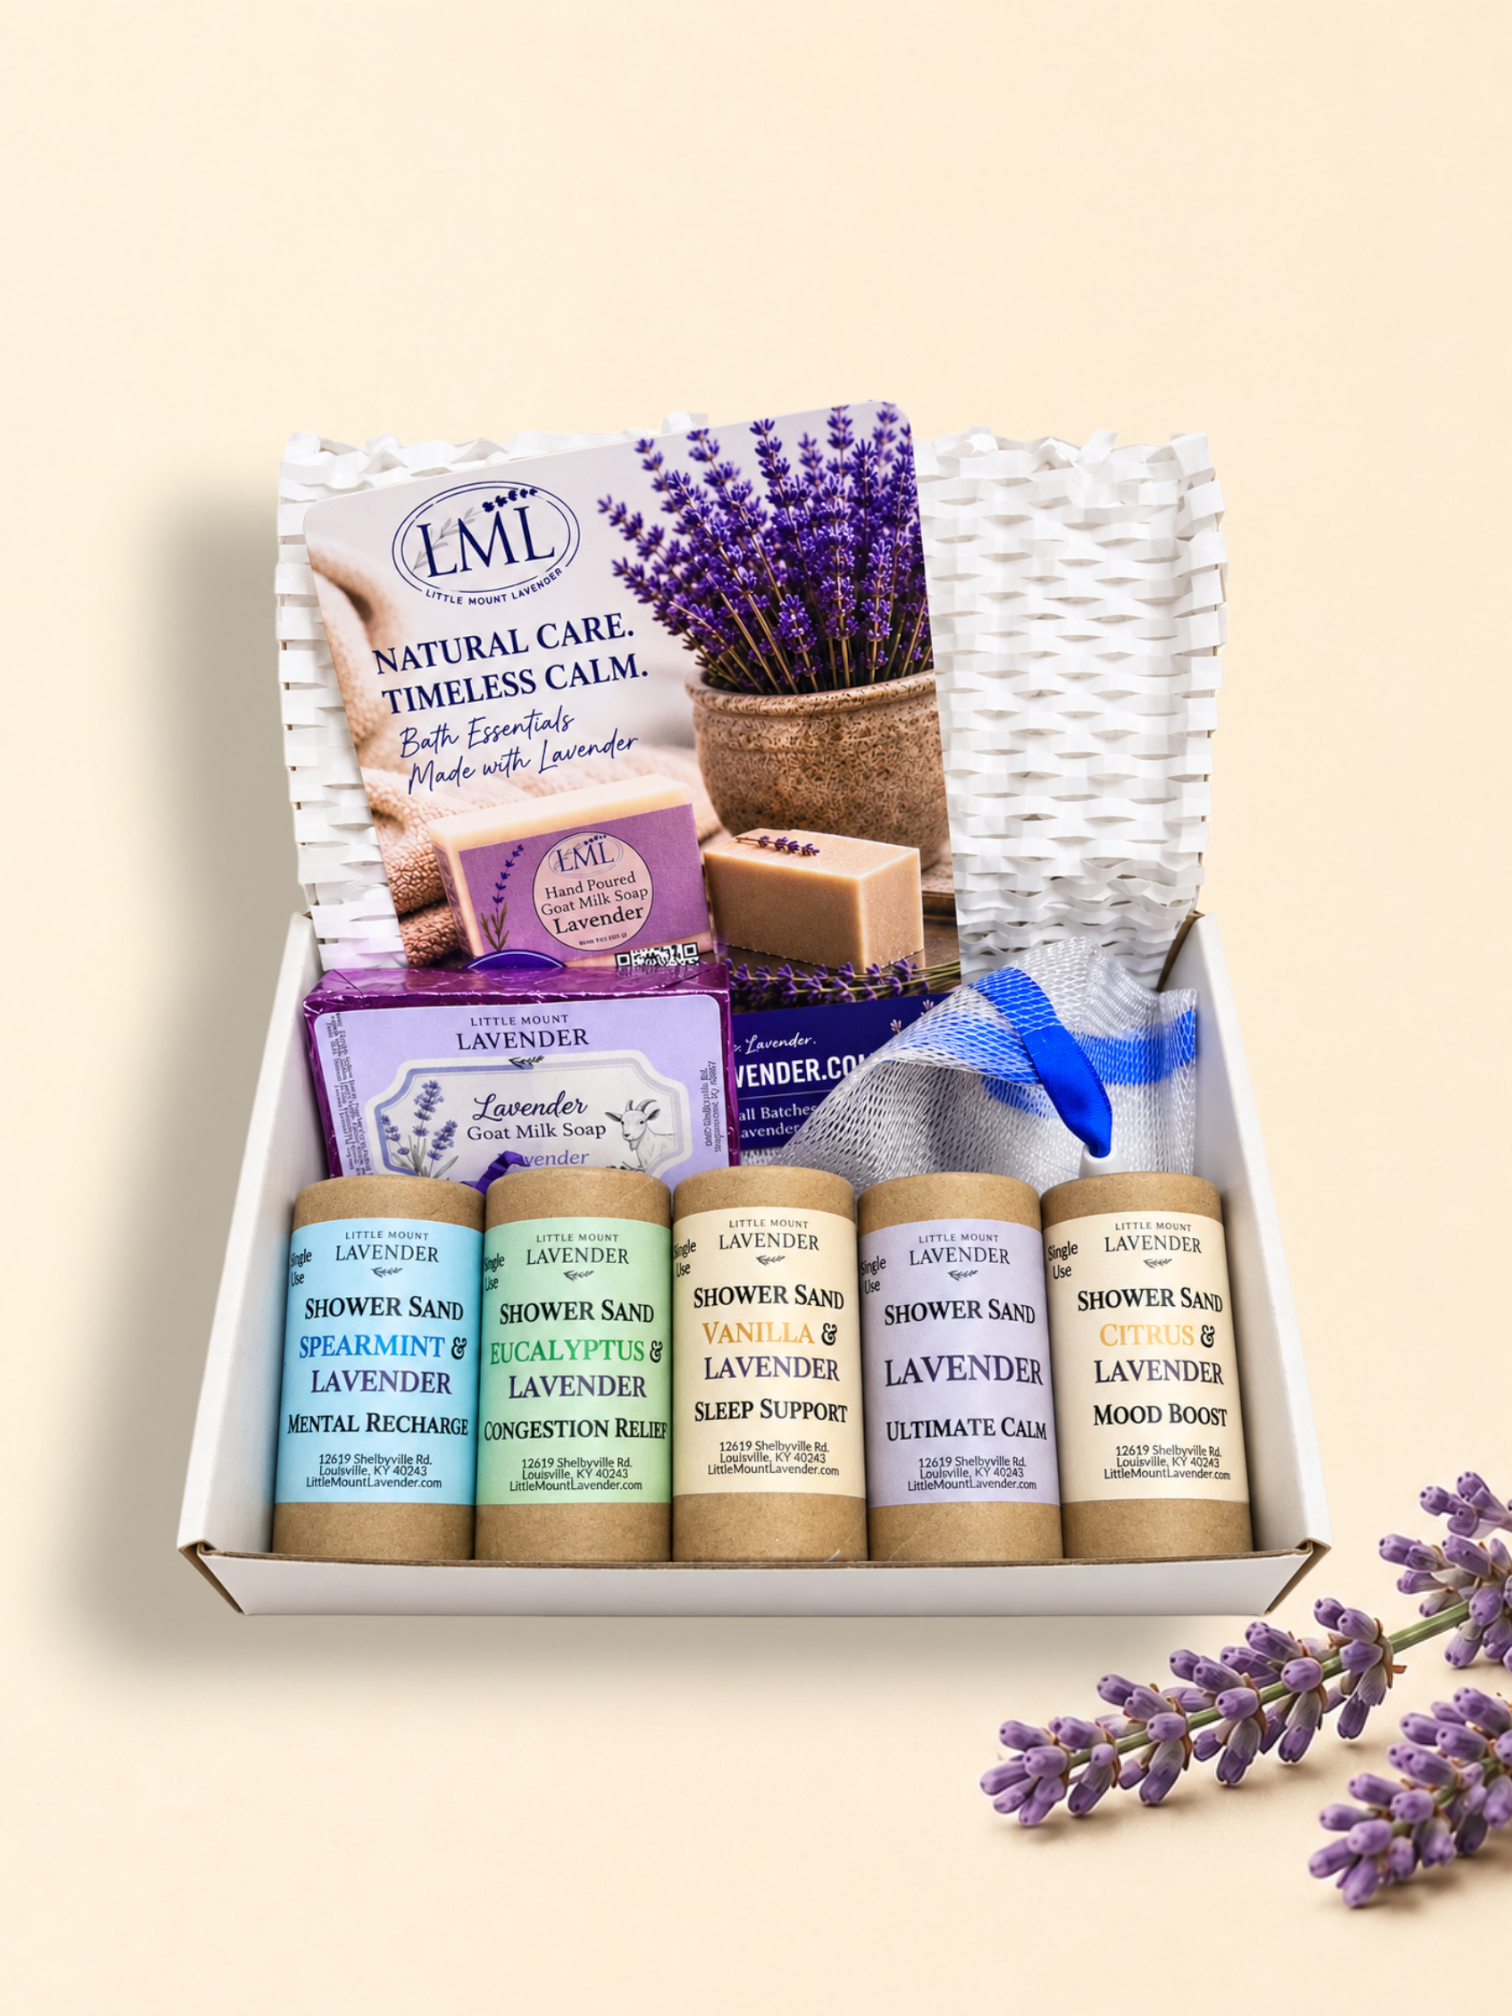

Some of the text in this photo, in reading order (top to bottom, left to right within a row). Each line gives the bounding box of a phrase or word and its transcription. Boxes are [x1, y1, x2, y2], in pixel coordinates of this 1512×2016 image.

[416, 505, 555, 578] LML
[425, 567, 563, 606] LITTLE MOUNT LAVENDER
[372, 612, 634, 675] NATURAL CARE.
[382, 653, 648, 715] TIMELESS CALM.
[399, 705, 575, 758] Bath Essentials
[408, 727, 639, 795] Made with Lavender
[556, 842, 614, 872] LML
[545, 871, 636, 899] Hand Poured
[541, 888, 649, 916] Goat Milk Soap
[553, 906, 644, 934] Lavender
[470, 1014, 569, 1026] LITTLE MOUNT
[456, 1028, 590, 1050] LAVENDER
[745, 1031, 816, 1055] Lavender.
[734, 1053, 874, 1088] VENDER.CO
[472, 1090, 588, 1122] Lavender
[738, 1107, 756, 1121] all
[467, 1122, 606, 1141] Goat Milk Soap
[740, 1121, 800, 1138] avender
[498, 1149, 590, 1167] vender
[729, 1219, 809, 1229] LITTLE MOUNT
[1115, 1222, 1191, 1232] LITTLE MOUNT
[346, 1231, 428, 1241] LITTLE MOUNT
[537, 1234, 618, 1243] LITTLE MOUNT
[719, 1233, 820, 1251] LAVENDER
[919, 1234, 999, 1243] LITTLE MOUNT
[1104, 1235, 1202, 1253] LAVENDER
[335, 1244, 439, 1263] LAVENDER
[526, 1247, 630, 1265] LAVENDER
[909, 1247, 1010, 1266] LAVENDER
[1048, 1240, 1078, 1261] Single
[676, 1262, 691, 1277] Use
[860, 1255, 886, 1276] Single
[1052, 1264, 1072, 1280] Use
[694, 1284, 844, 1310] SHOWER SAND
[864, 1279, 881, 1294] Use
[305, 1296, 464, 1321] SHOWER SAND
[1078, 1287, 1223, 1312] SHOWER SAND
[500, 1299, 654, 1324] SHOWER SAND
[885, 1299, 1035, 1326] SHOWER SAND
[702, 1321, 837, 1346] VANILLA &
[1100, 1323, 1215, 1348] CITRUS &
[300, 1335, 467, 1359] SPEARMINT &
[490, 1340, 663, 1365] EUCALYPTUS &
[704, 1356, 840, 1381] LAVENDER
[885, 1355, 1044, 1387] LAVENDER
[1094, 1359, 1224, 1385] LAVENDER
[311, 1370, 452, 1394] LAVENDER
[509, 1375, 647, 1399] LAVENDER
[695, 1398, 848, 1423] SLEEP SUPPORT
[1093, 1403, 1227, 1427] MOOD BOOST
[288, 1413, 469, 1436] MENTAL RECHARGE
[485, 1418, 667, 1441] CONGESTION RELIEF
[886, 1417, 1047, 1441] ULTIMATE CALM
[719, 1441, 829, 1452] 12619 Shelbyville Rd.
[1116, 1445, 1222, 1457] 12619 Shelbyville Rd.
[319, 1454, 432, 1466] 12619 Shelbyville Rd.
[522, 1458, 632, 1469] 12619 Shelbyville Rd.
[720, 1453, 826, 1463] Louisville, KY 40243
[919, 1456, 1026, 1468] 12619 Shelbyville Rd.
[1116, 1457, 1219, 1468] Louisville, KY 40243
[319, 1465, 427, 1476] Louisville, KY 40243
[522, 1469, 628, 1480] Louisville, KY 40243
[708, 1464, 839, 1476] LittleMountLavender.com
[920, 1468, 1024, 1480] Louisville, KY 40243
[1104, 1468, 1231, 1480] LittleMountLavender.com
[306, 1477, 442, 1488] LittleMountLavender.com
[510, 1480, 642, 1491] LittleMountLavender.com
[908, 1479, 1037, 1491] LittleMountLavender.com
